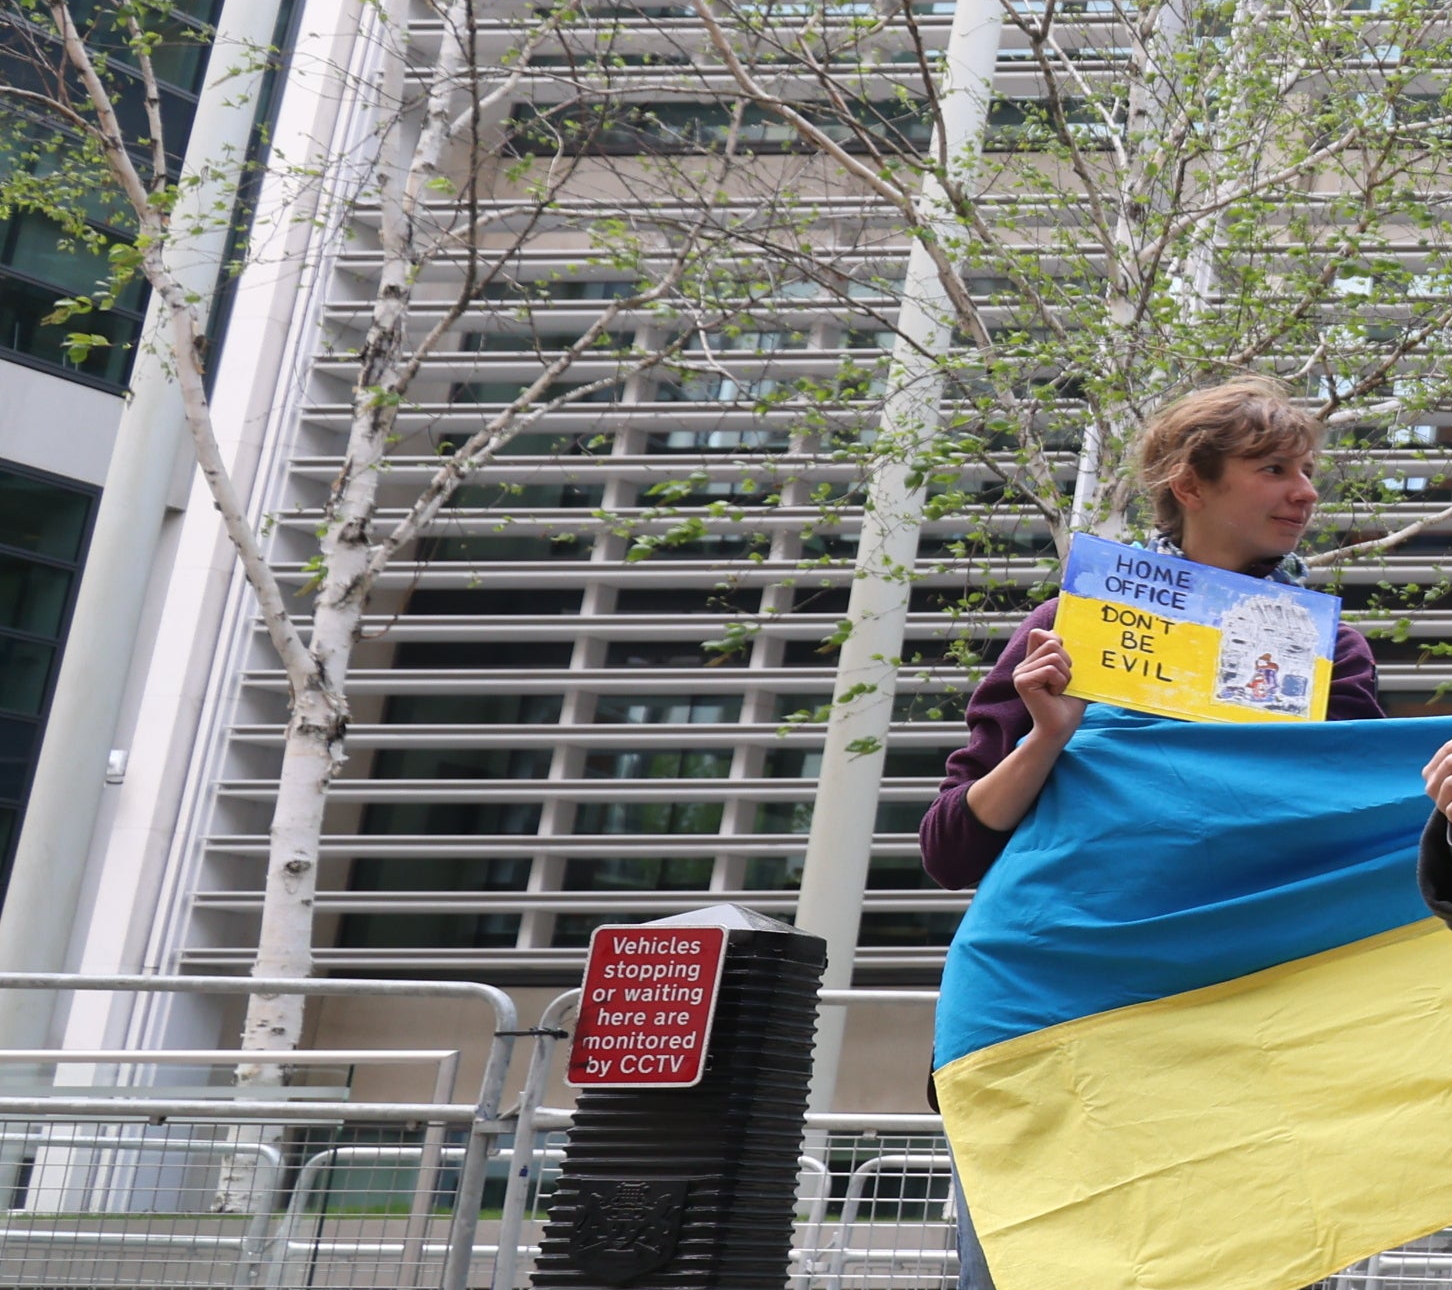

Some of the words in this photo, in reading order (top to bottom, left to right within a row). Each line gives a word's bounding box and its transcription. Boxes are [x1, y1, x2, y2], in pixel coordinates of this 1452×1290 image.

[1116, 554, 1192, 589] HOME
[1105, 576, 1187, 610] OFFICE
[1101, 605, 1176, 635] DON'T
[1121, 631, 1154, 653] BE
[1102, 651, 1172, 682] EVIL
[613, 937, 701, 955] Vehicles
[604, 961, 700, 981] stopping
[592, 987, 616, 1003] or
[624, 984, 704, 1005] waiting
[597, 1007, 646, 1026] here
[654, 1011, 690, 1026] are
[583, 1031, 696, 1049] monitored
[586, 1056, 612, 1077] by
[620, 1055, 684, 1073] CCTV
